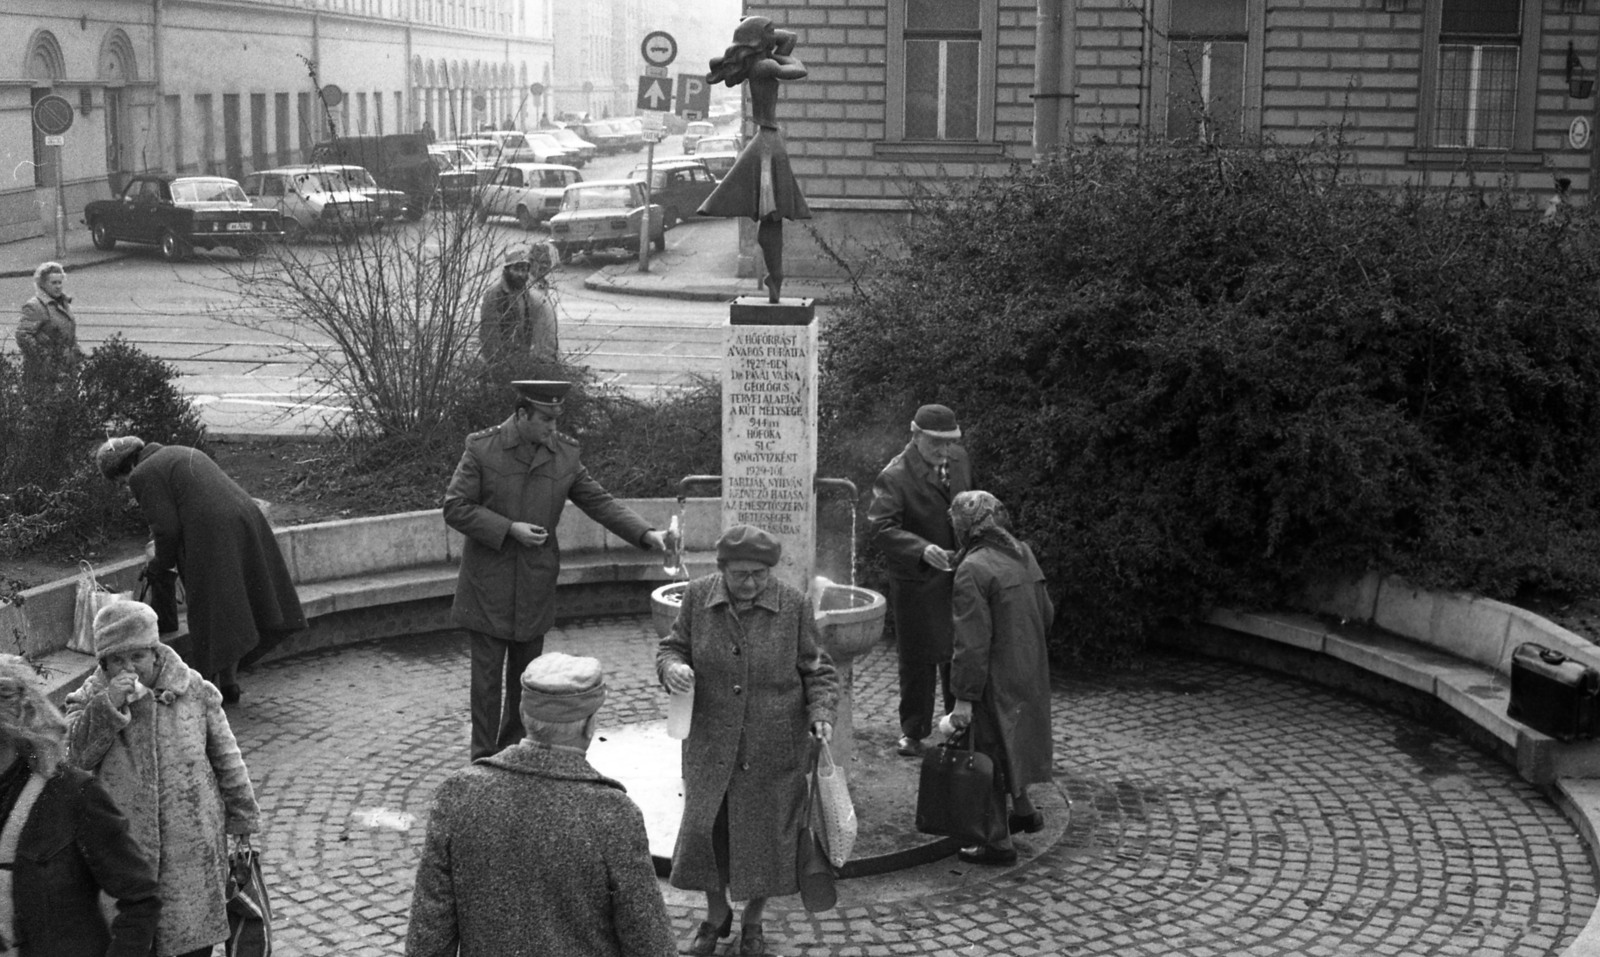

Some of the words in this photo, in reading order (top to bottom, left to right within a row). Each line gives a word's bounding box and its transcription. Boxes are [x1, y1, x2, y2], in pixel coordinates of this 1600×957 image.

[684, 78, 703, 104] P
[736, 335, 742, 345] A
[744, 380, 790, 392] GEOLÓGUS
[730, 393, 761, 404] TERVEI
[763, 392, 801, 404] ALAPJÁN
[729, 406, 737, 416] A
[739, 403, 755, 416] KÚT
[749, 417, 766, 427] 944
[747, 426, 781, 439] HŐFOKA
[755, 440, 764, 451] 51
